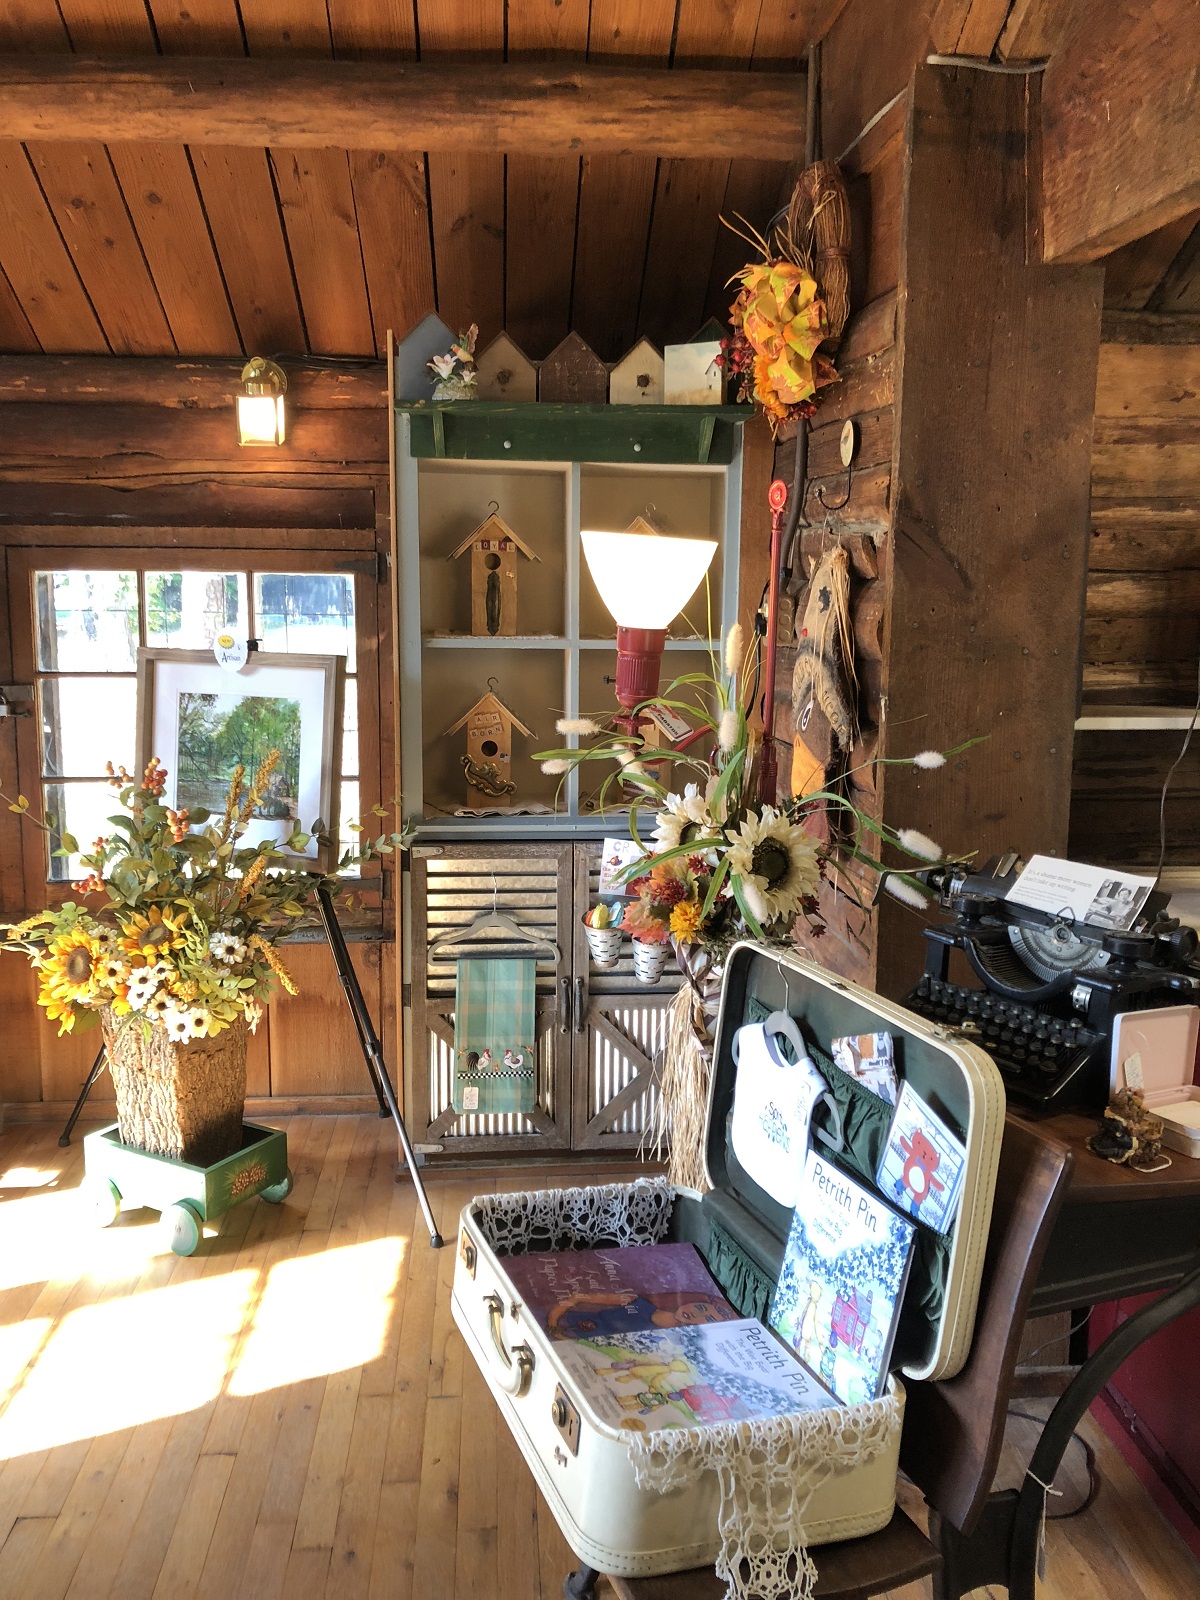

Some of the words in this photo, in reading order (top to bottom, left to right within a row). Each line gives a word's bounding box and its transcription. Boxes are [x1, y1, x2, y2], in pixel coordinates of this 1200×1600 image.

[475, 541, 514, 551] LOYAL
[812, 1162, 852, 1212] Petrith
[857, 1197, 877, 1233] Pin
[594, 1250, 621, 1282] Anna
[740, 1327, 789, 1370] Petrith
[782, 1372, 810, 1396] Pin
